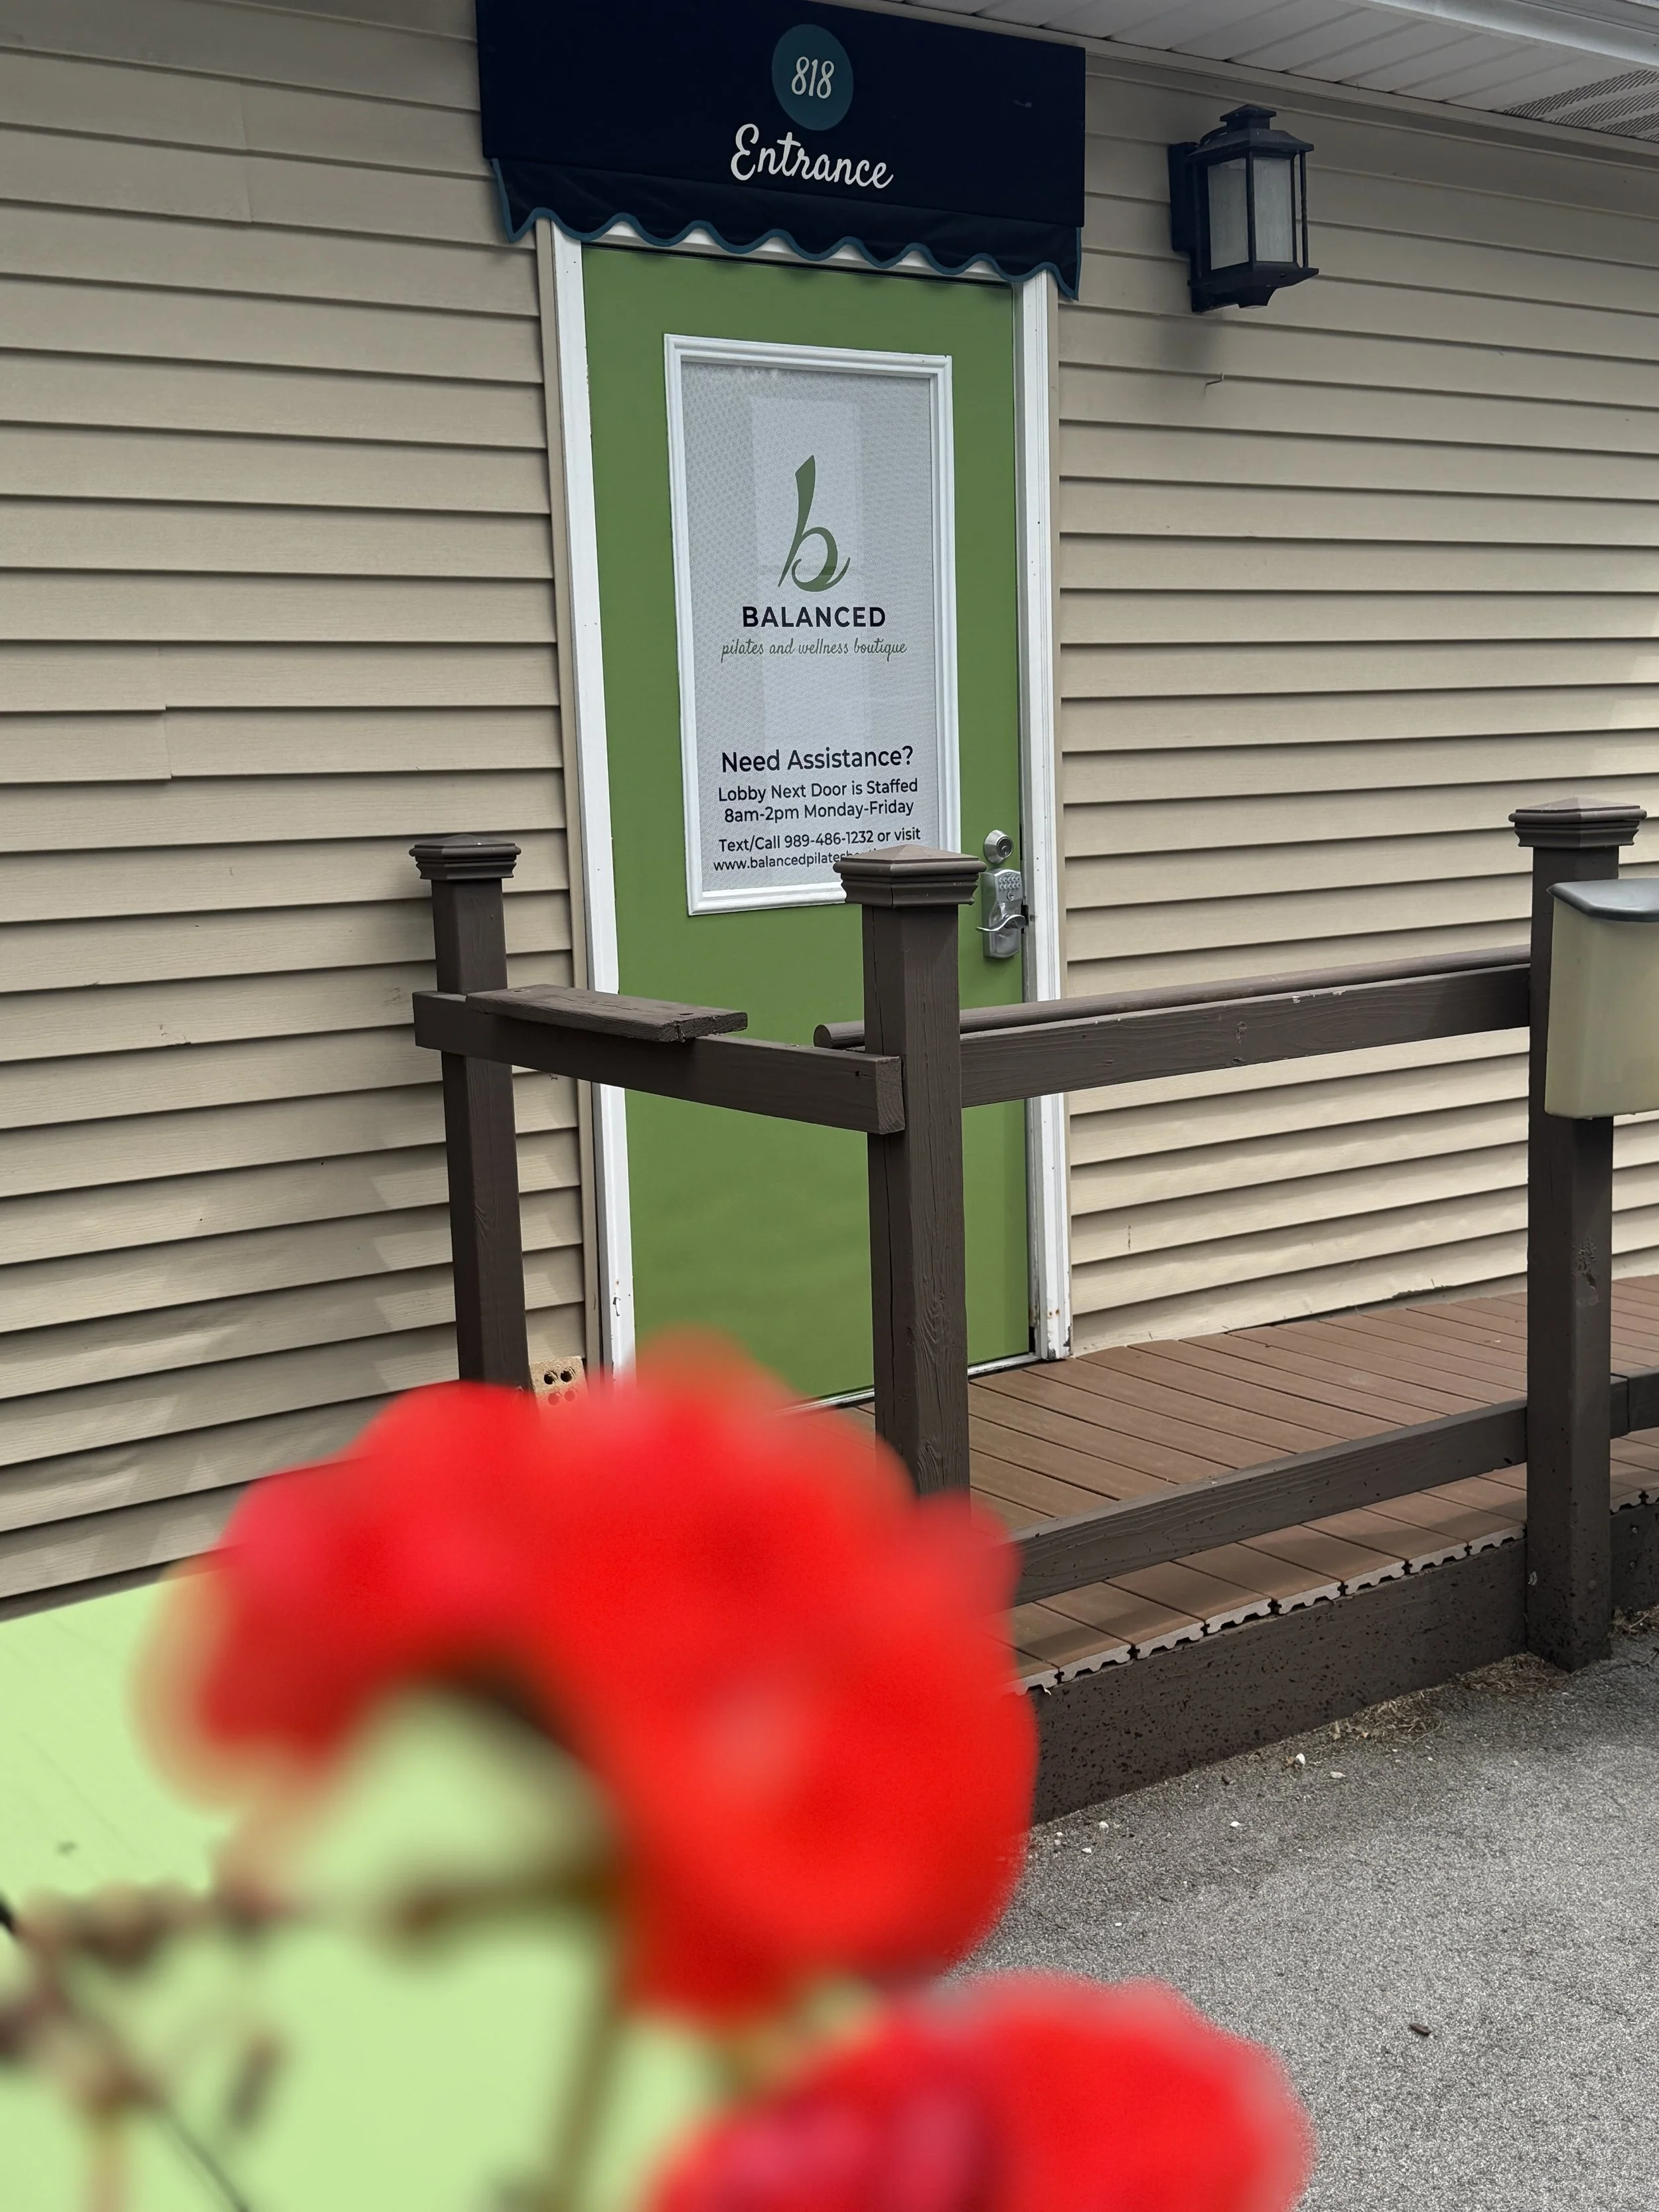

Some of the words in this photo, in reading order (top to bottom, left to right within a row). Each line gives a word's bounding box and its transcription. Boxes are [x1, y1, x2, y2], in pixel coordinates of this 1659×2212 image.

[791, 56, 835, 99] 818
[731, 123, 893, 188] Entrance
[743, 606, 886, 627] BALANCED
[721, 638, 764, 663] pilates
[769, 638, 795, 654] and
[799, 638, 849, 654] wellness
[854, 638, 907, 662] boutique
[722, 750, 780, 773] Need
[787, 745, 914, 770] Assistance?
[718, 786, 766, 803] Lobby
[771, 784, 806, 799] Next
[811, 782, 847, 798] Door
[851, 780, 863, 795] is
[867, 778, 918, 794] Staffed
[724, 806, 800, 824] 8am-2pm
[804, 800, 914, 819] Monday-Friday
[719, 835, 780, 852] Text/Call
[784, 830, 875, 847] 989-486-1232
[877, 831, 891, 842] or
[894, 827, 921, 841] visit
